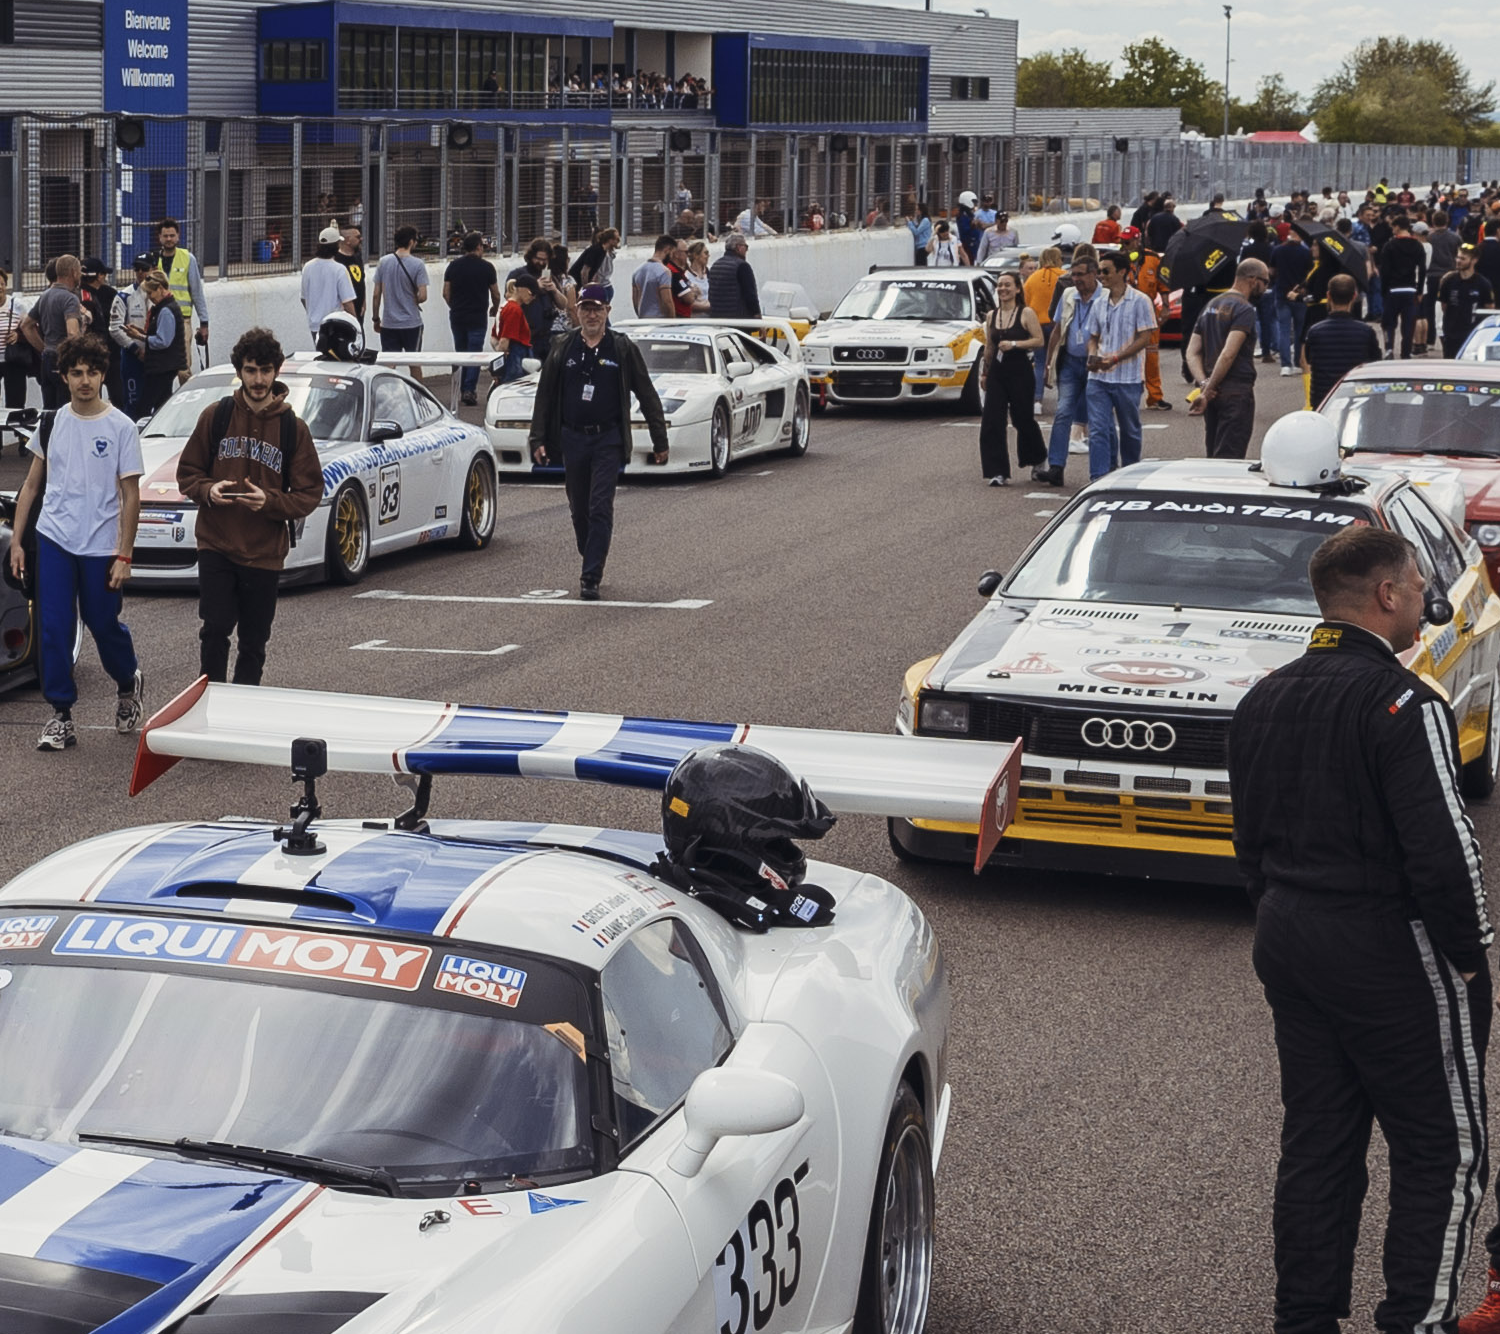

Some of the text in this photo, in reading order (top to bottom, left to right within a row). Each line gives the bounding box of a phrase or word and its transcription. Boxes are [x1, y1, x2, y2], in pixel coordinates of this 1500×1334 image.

[125, 10, 171, 32] Bienvenue
[128, 39, 168, 60] Welcome
[121, 67, 175, 88] Willkommen
[921, 282, 957, 291] TEAM
[171, 388, 206, 406] 83
[380, 481, 399, 517] 83
[1090, 500, 1355, 527] HB Audi TEAM
[1161, 621, 1192, 638] 1
[1103, 663, 1198, 680] Audi
[1058, 683, 1218, 703] MICHELIN
[65, 915, 425, 988] LIQUI MOLY
[443, 956, 527, 989] LIQUI
[438, 970, 520, 1005] MOLY
